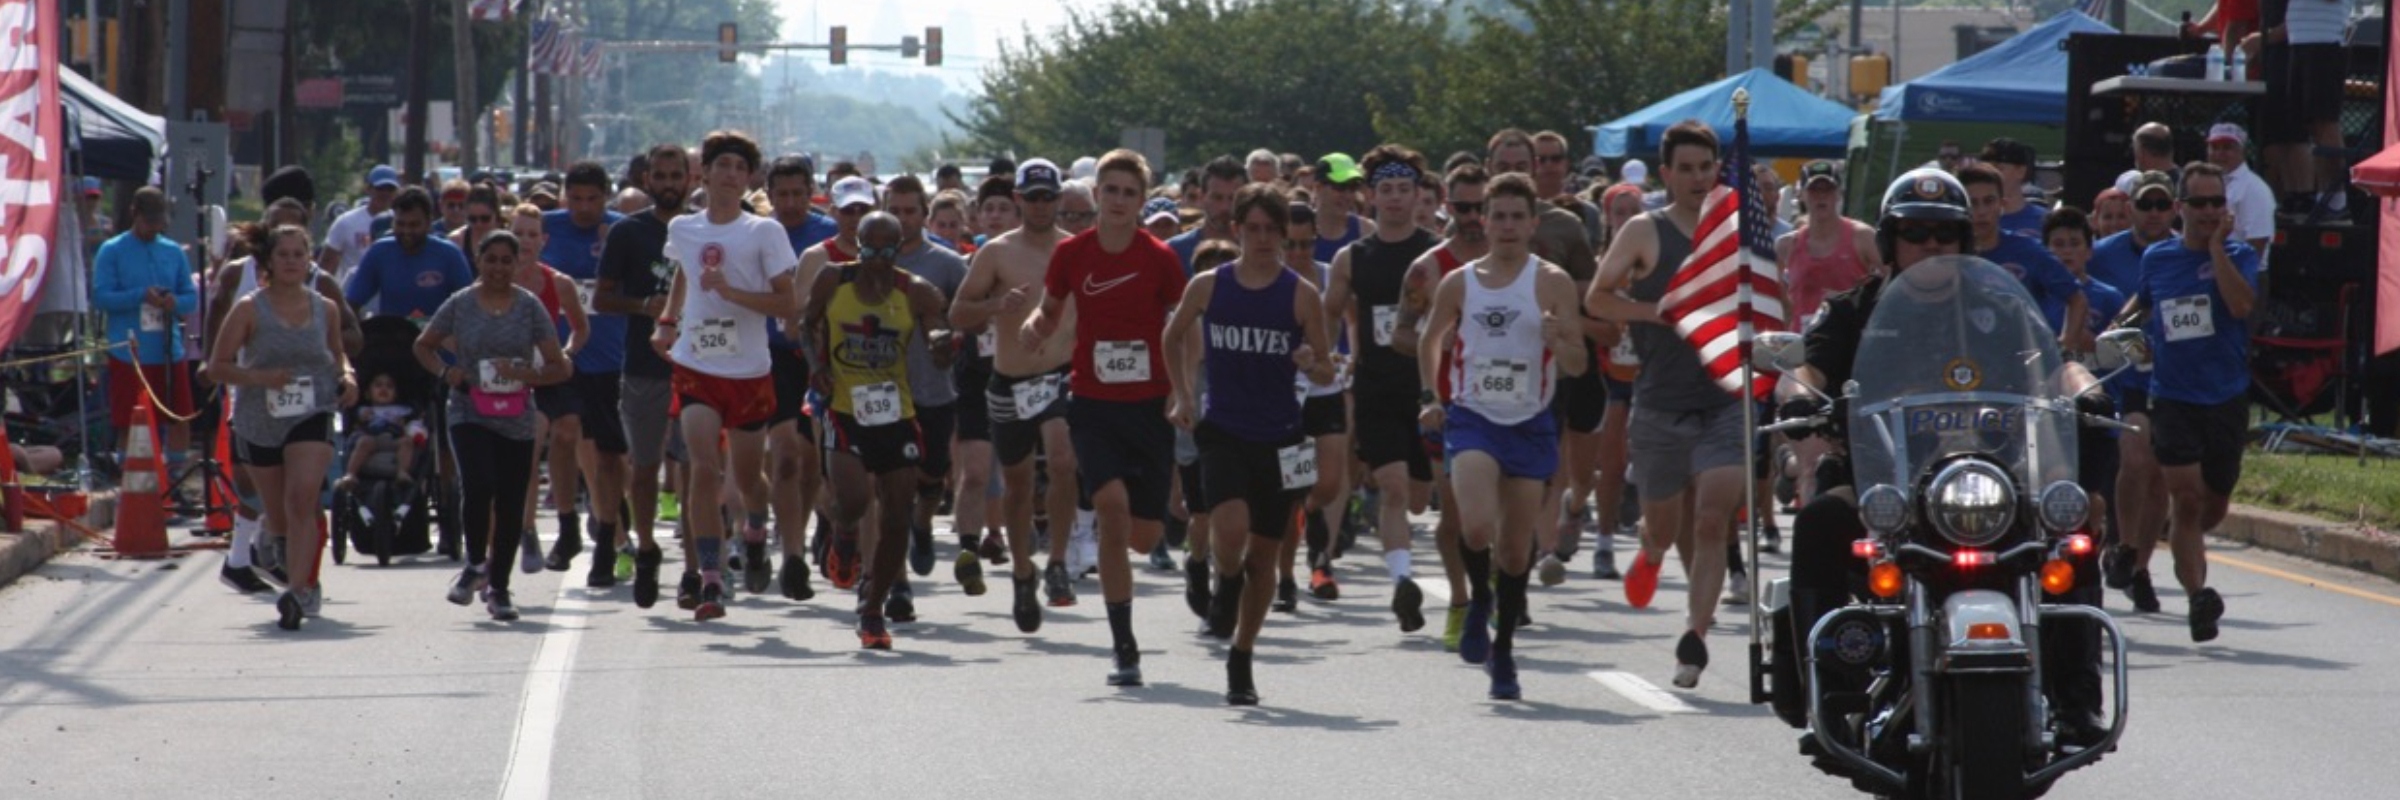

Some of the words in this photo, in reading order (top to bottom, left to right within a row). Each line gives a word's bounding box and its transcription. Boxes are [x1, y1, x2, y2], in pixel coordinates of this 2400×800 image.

[2171, 312, 2200, 329] 640
[700, 333, 727, 348] 526
[1209, 323, 1291, 355] WOLVES
[1106, 356, 1137, 371] 462
[1482, 375, 1515, 392] 668
[278, 392, 303, 407] 572
[864, 398, 891, 415] 639
[1911, 408, 2014, 433] POLICE
